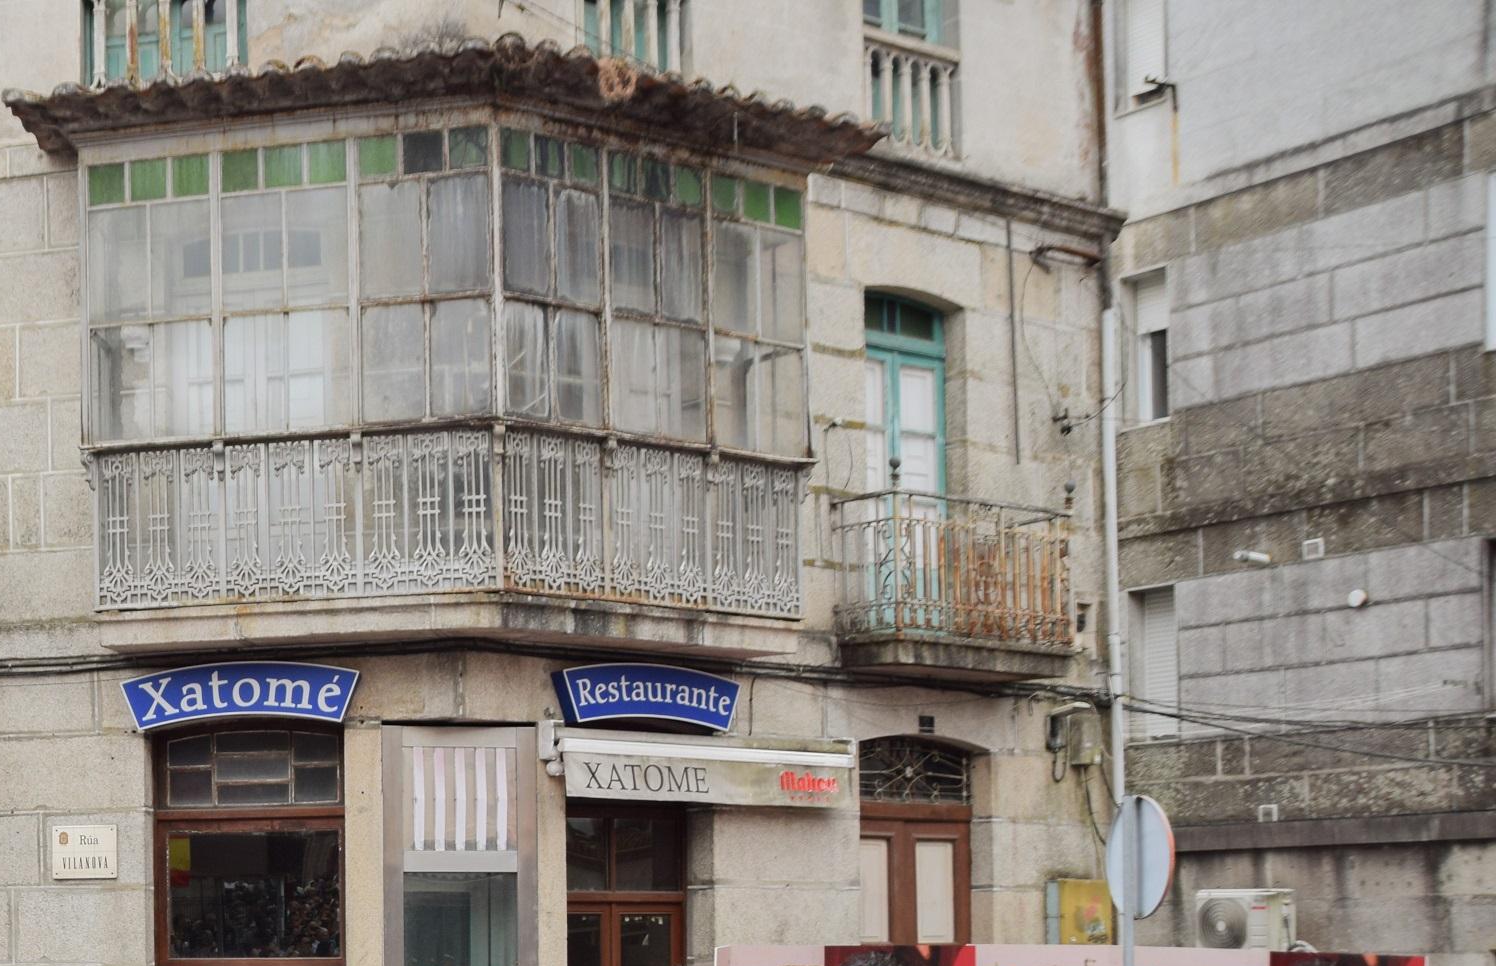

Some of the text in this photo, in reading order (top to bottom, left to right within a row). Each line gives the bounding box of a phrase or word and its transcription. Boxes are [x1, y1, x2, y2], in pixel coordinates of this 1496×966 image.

[138, 670, 342, 722] Xatomé
[576, 674, 731, 716] Restaurante
[583, 761, 710, 794] XATOME
[62, 856, 109, 870] VILANOVA
